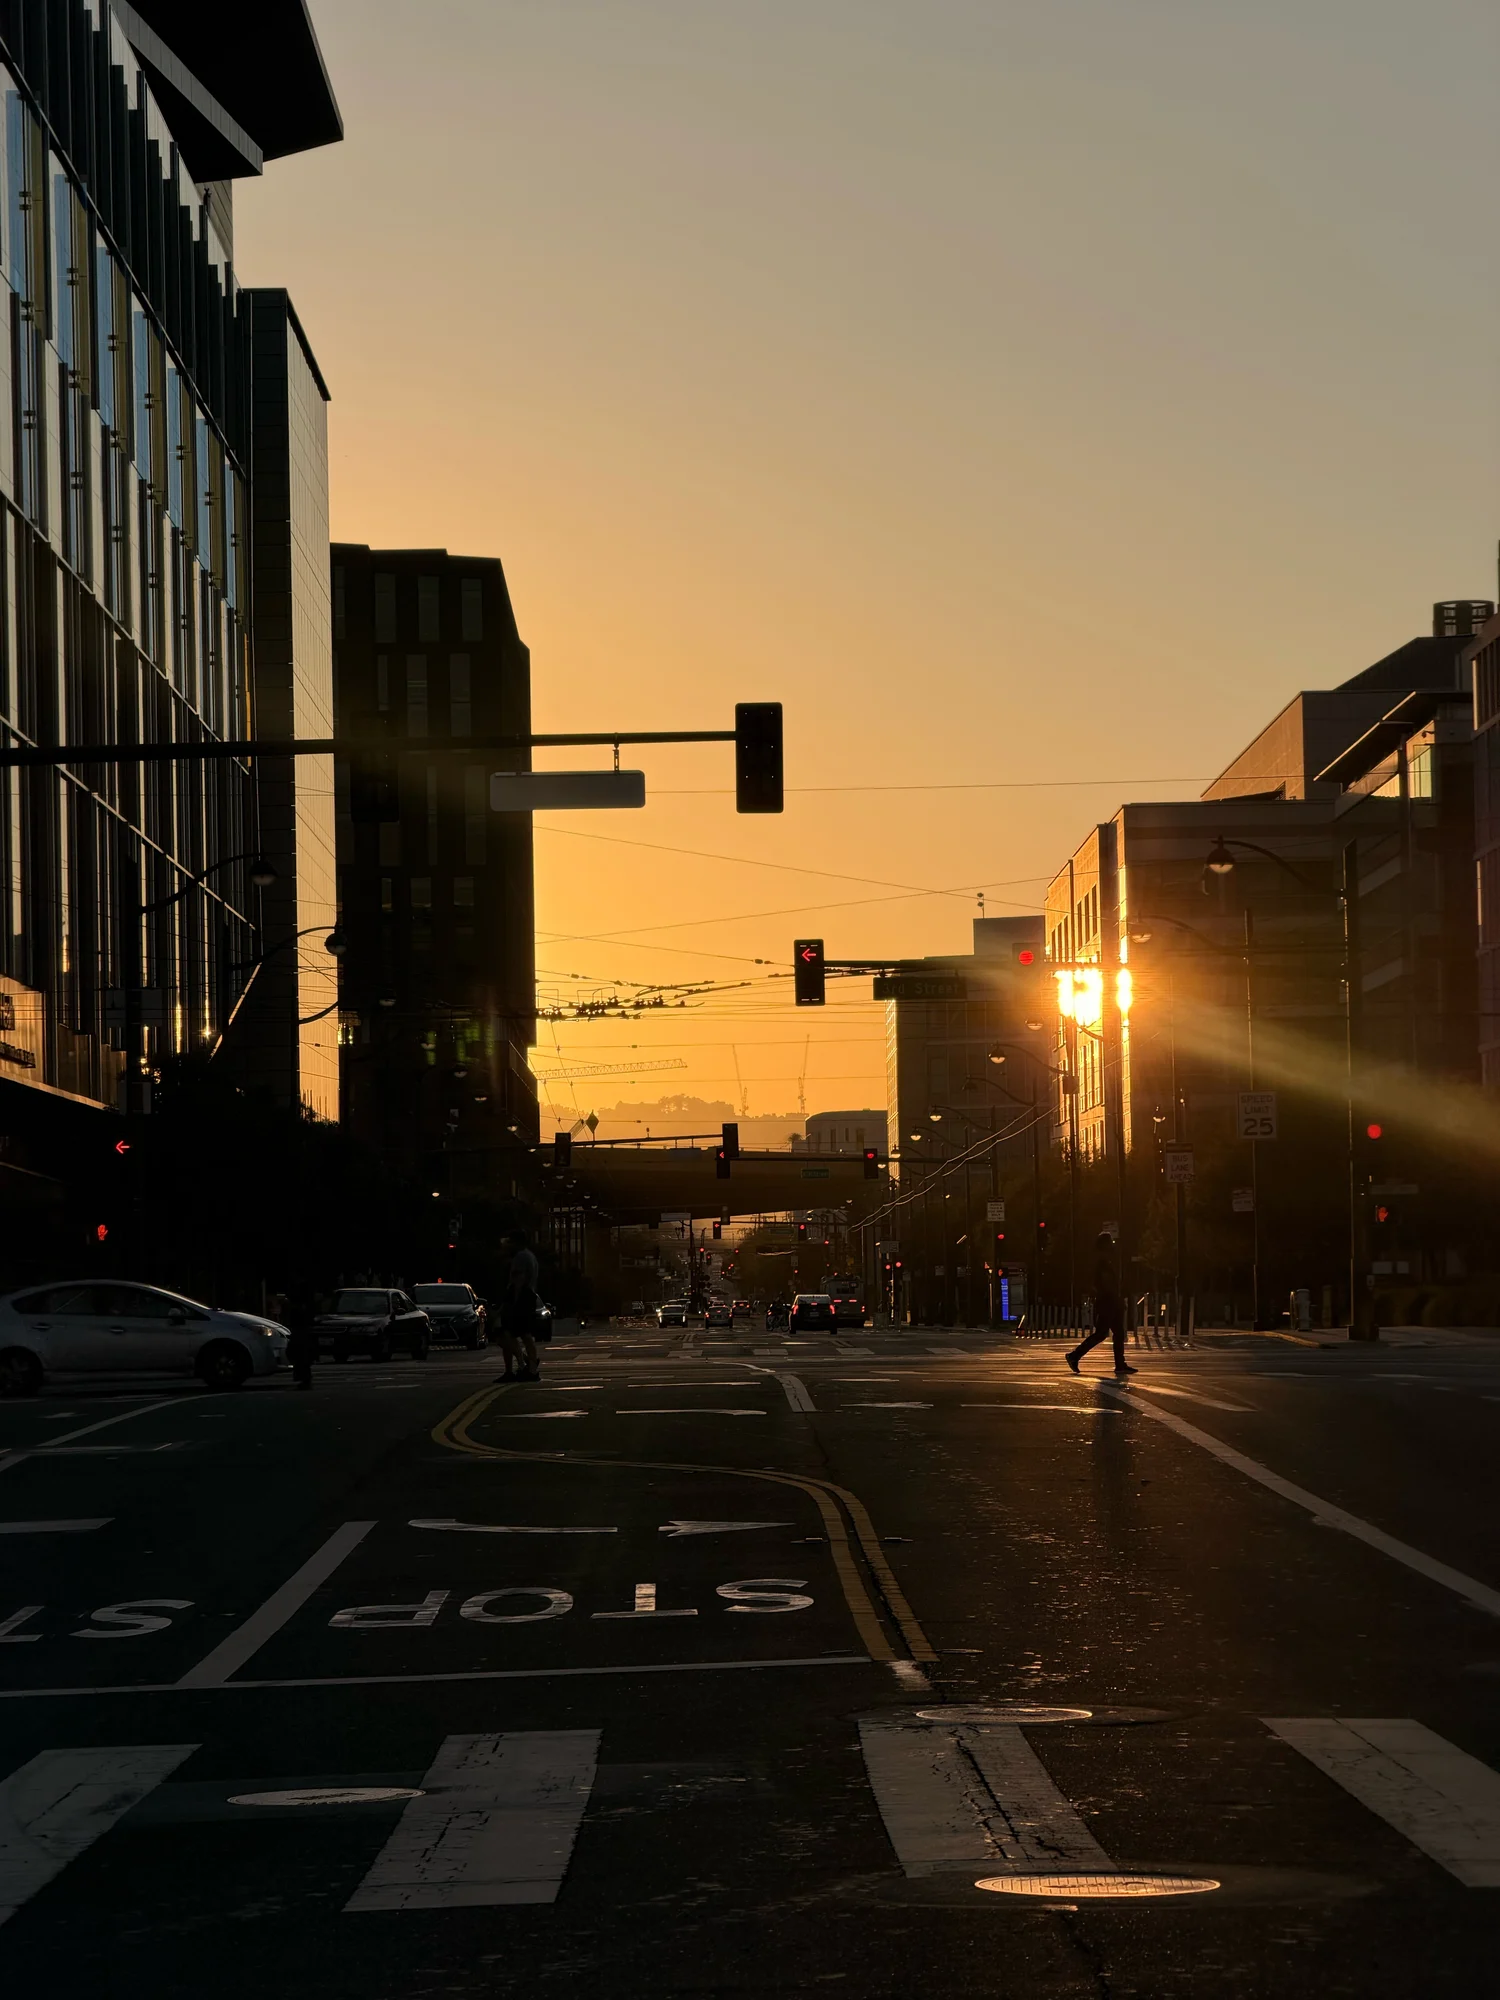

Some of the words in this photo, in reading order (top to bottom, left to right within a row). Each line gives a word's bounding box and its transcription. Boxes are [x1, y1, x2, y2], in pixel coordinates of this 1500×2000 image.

[882, 983, 904, 994] 3rd
[914, 982, 958, 995] Street
[1241, 1095, 1273, 1103] SPEED
[1244, 1106, 1270, 1114] LIMIT
[1243, 1117, 1273, 1136] 25
[1171, 1164, 1189, 1172] LANE
[328, 1578, 814, 1628] STOP
